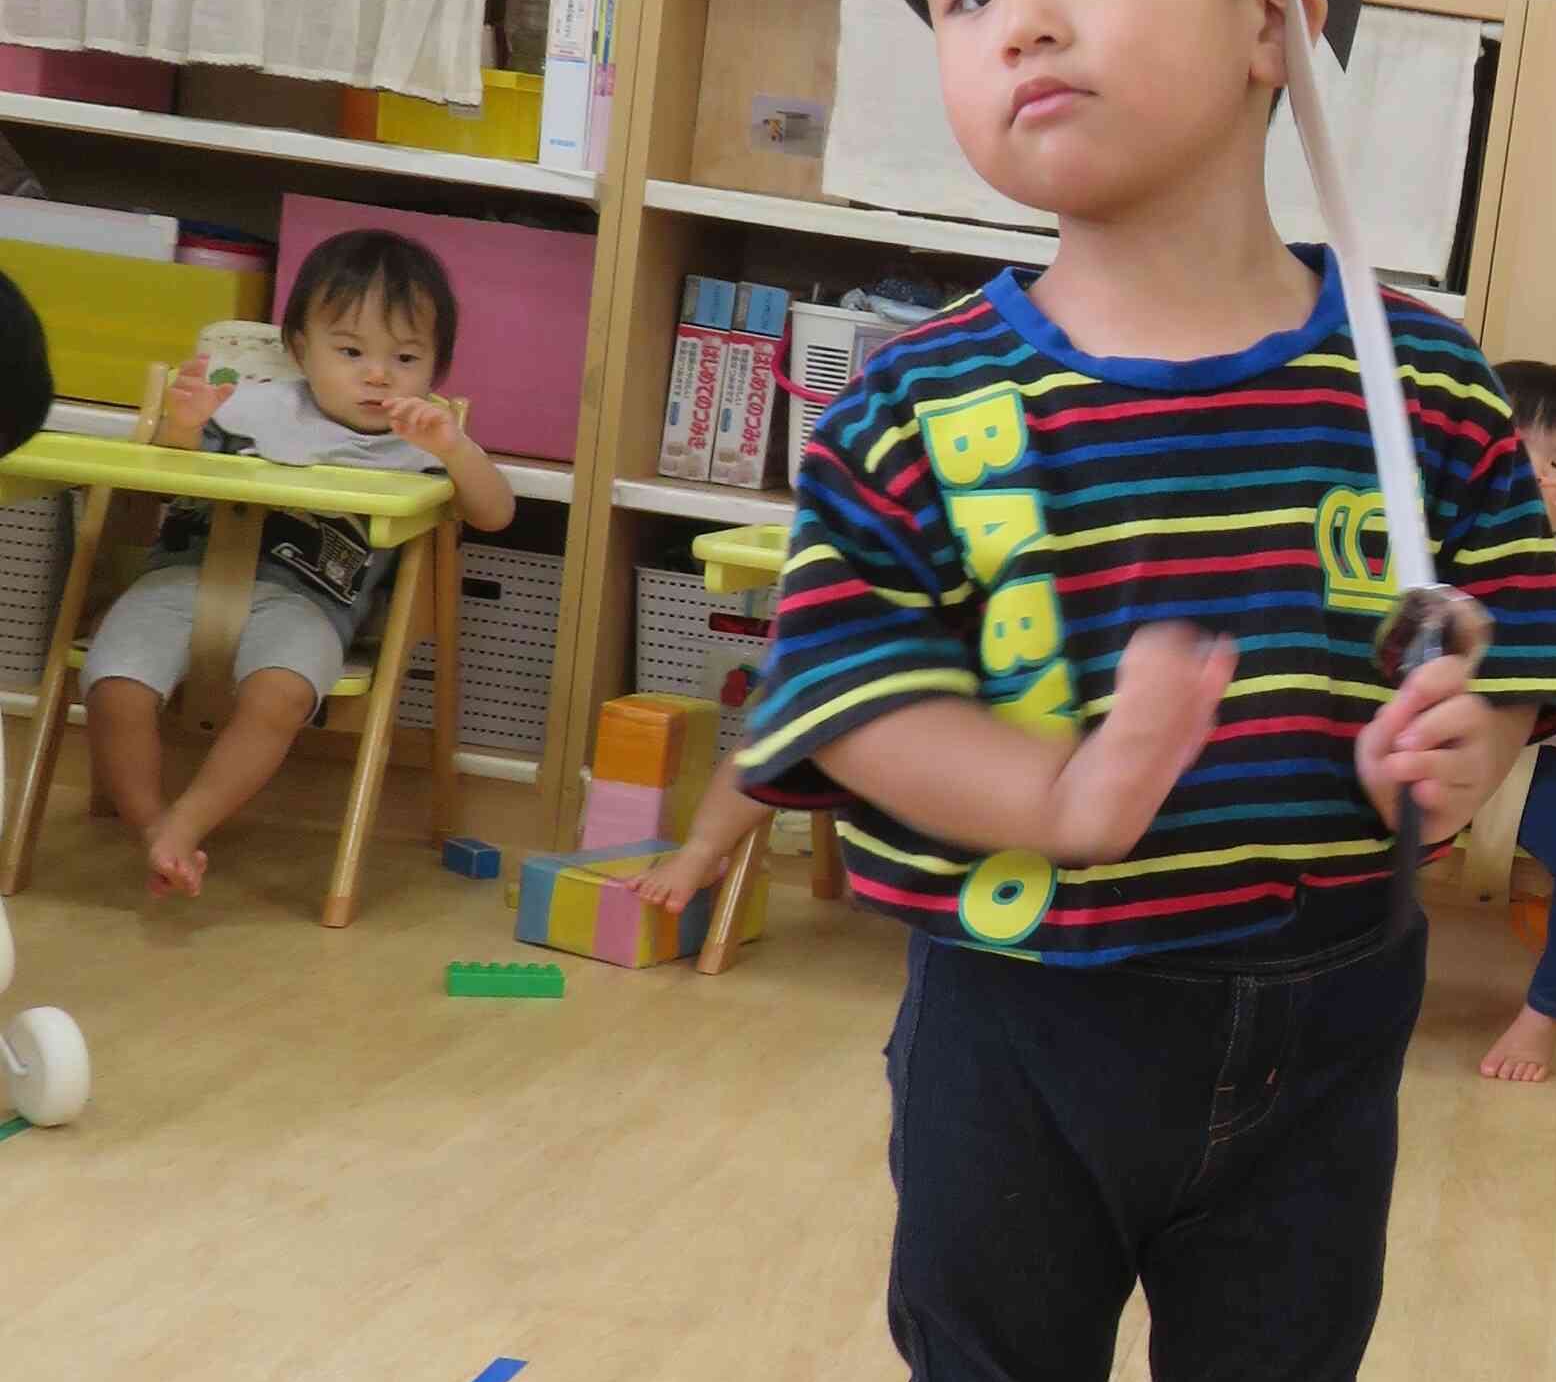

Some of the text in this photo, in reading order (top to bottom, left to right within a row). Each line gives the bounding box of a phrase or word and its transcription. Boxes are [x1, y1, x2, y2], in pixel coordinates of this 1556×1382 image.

[688, 343, 722, 450] はじめてのつみき
[740, 347, 773, 457] はじめてのつみき
